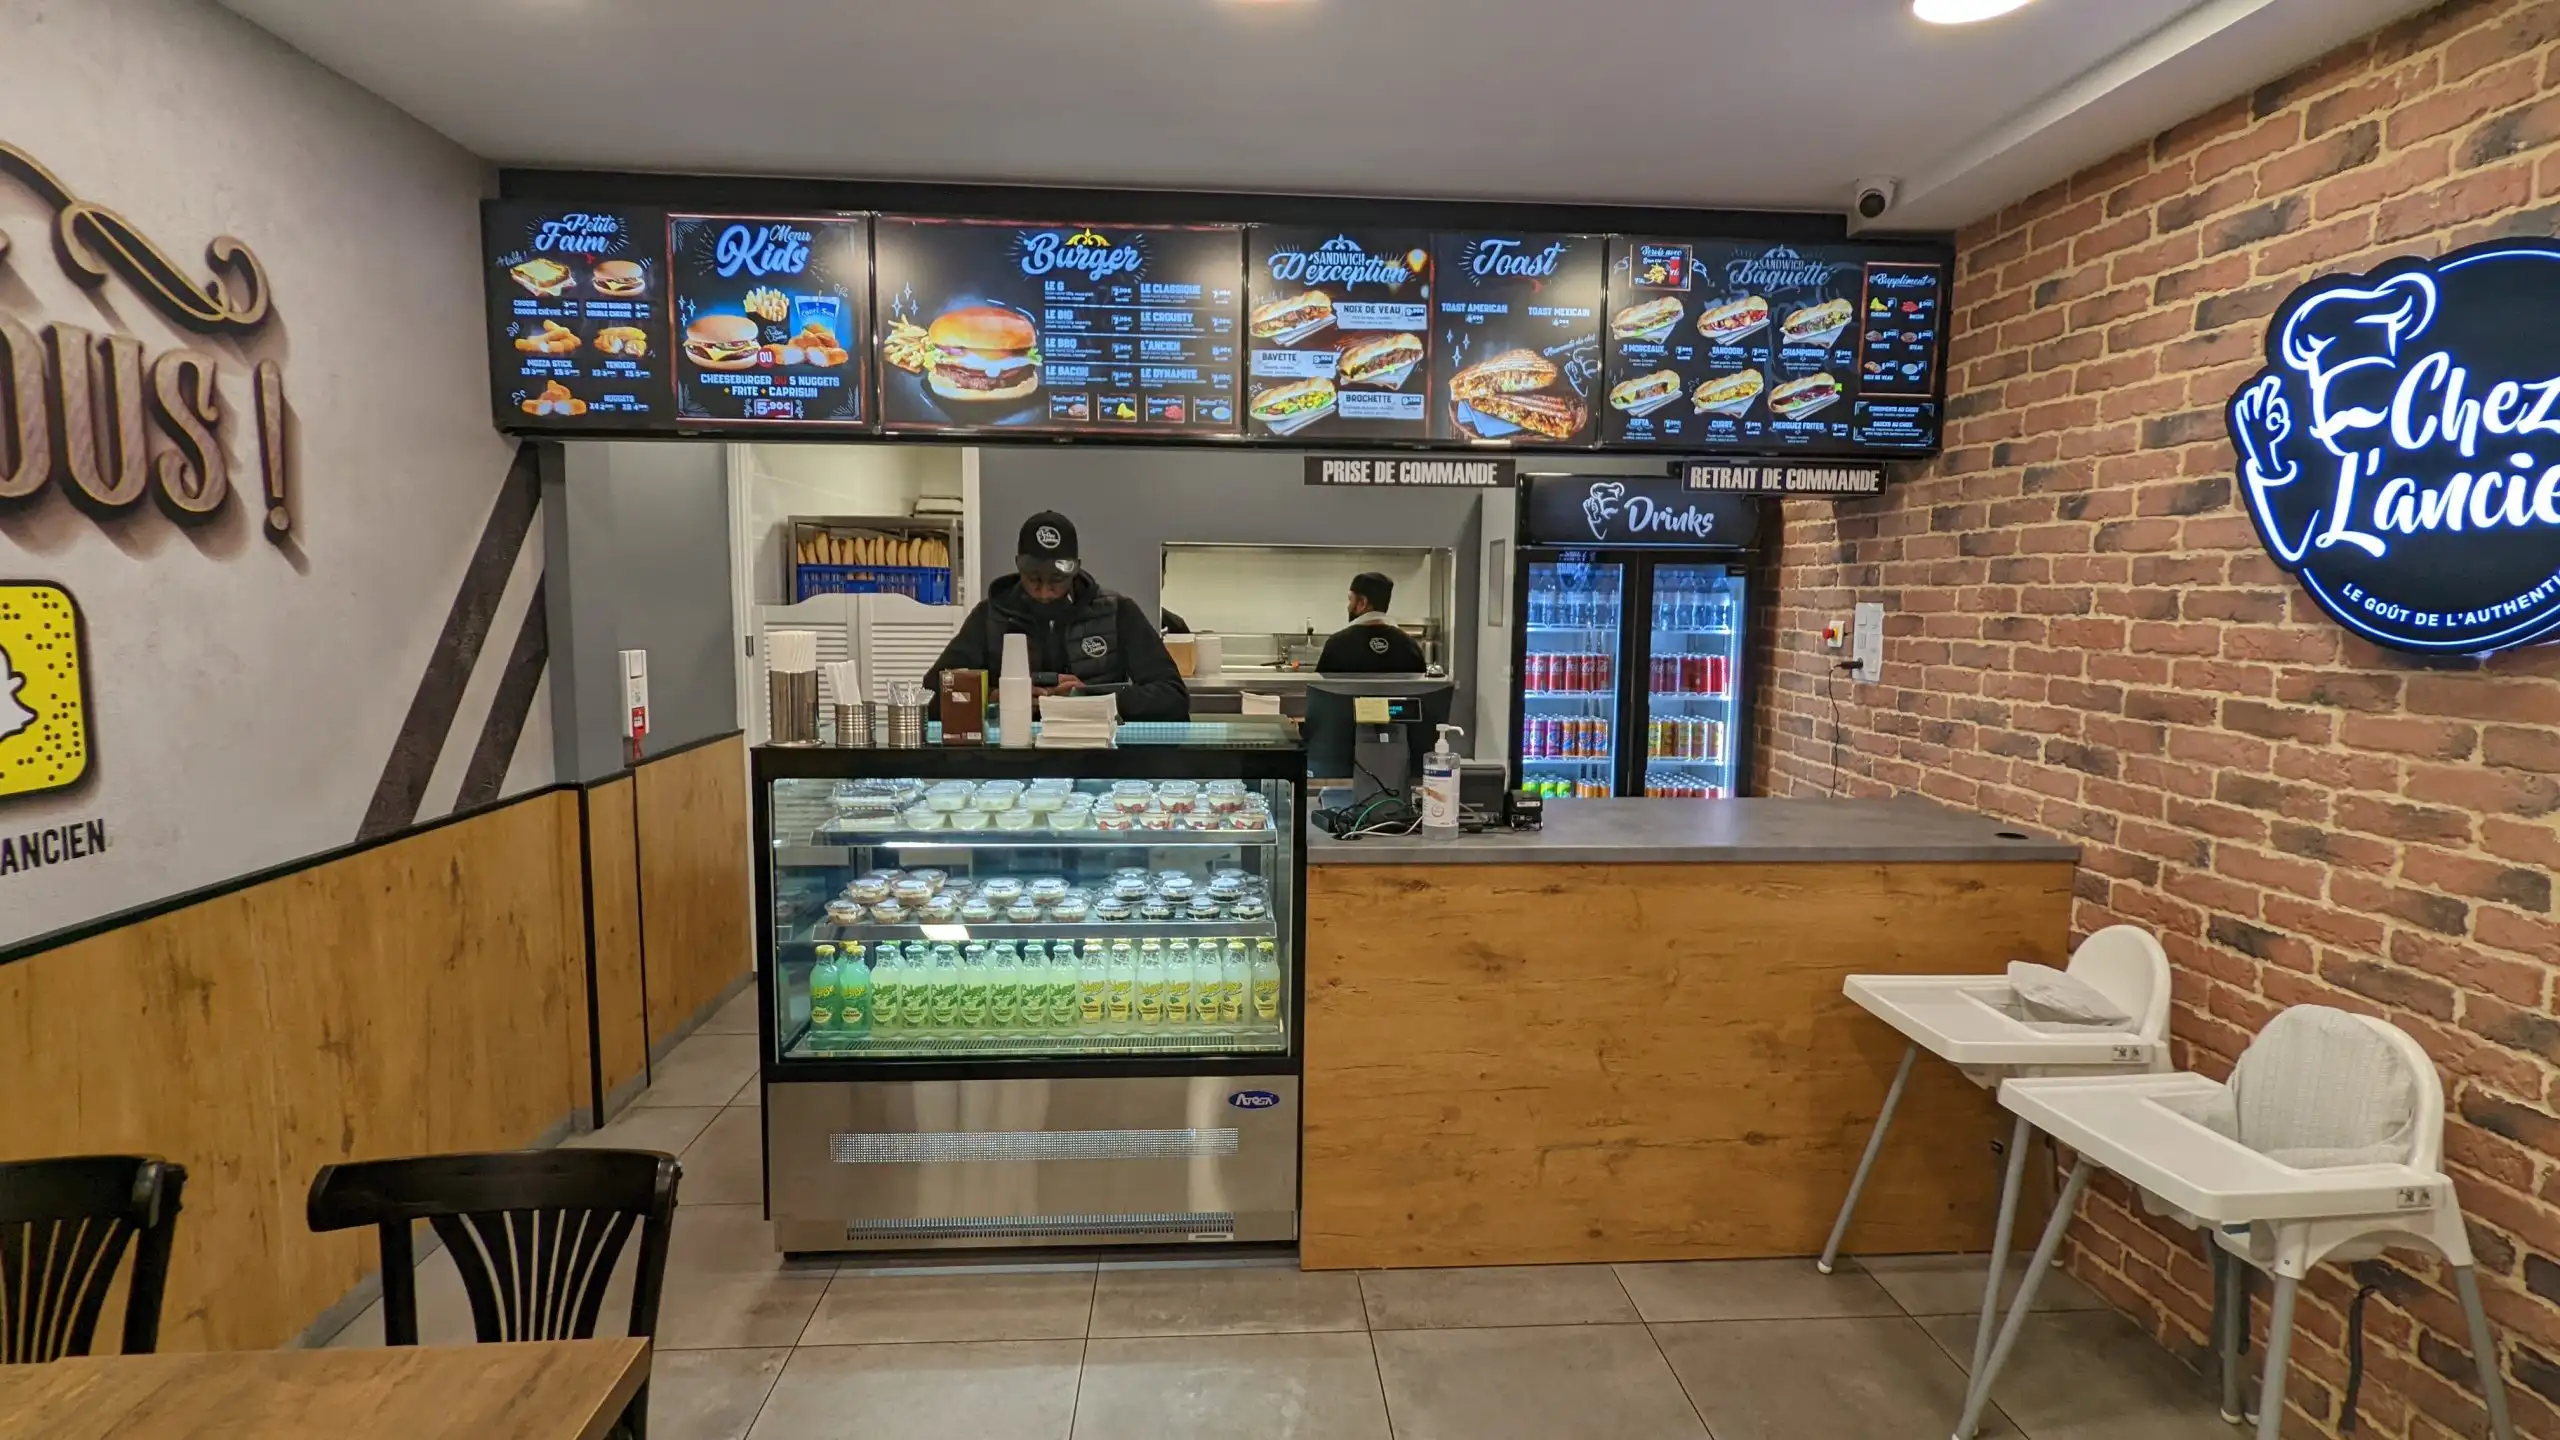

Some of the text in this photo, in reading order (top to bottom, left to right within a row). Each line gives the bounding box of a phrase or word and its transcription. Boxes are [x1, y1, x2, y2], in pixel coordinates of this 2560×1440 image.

[563, 213, 619, 233] Petite
[535, 222, 610, 253] Faim
[770, 224, 812, 242] Menu
[717, 224, 810, 278] Kids
[1021, 232, 1143, 281] Burger
[1313, 252, 1366, 266] SANDWICH
[1473, 239, 1568, 277] Toast
[1758, 259, 1804, 270] SANDWICH
[1726, 259, 1834, 292] Baguette
[1045, 281, 1056, 291] LE
[1140, 284, 1151, 294] LE
[1344, 305, 1401, 314] NOIX DE VEAU
[1441, 303, 1508, 313] TOAST AMERICAN
[1528, 307, 1590, 317] TOAST MEXICAIN
[1045, 309, 1056, 319] LE
[1140, 312, 1151, 322] LE
[1045, 338, 1056, 348] LE
[759, 352, 772, 363] OU
[1262, 353, 1297, 362] BAVETTE
[1045, 366, 1056, 376] LE
[1140, 368, 1151, 378] LE
[700, 374, 772, 386] CHEESEBURGER
[799, 376, 840, 387] NUGGETS
[732, 386, 759, 396] FRITE
[769, 387, 818, 398] CAPRISUN
[1346, 394, 1391, 403] BROCHETTE
[1322, 460, 1498, 485] PRISE DE COMMANDE
[1690, 466, 1879, 492] RETRAIT DE COMMANDE
[1623, 496, 1715, 538] Drinks
[2342, 583, 2364, 602] LE
[2414, 612, 2440, 627] DE
